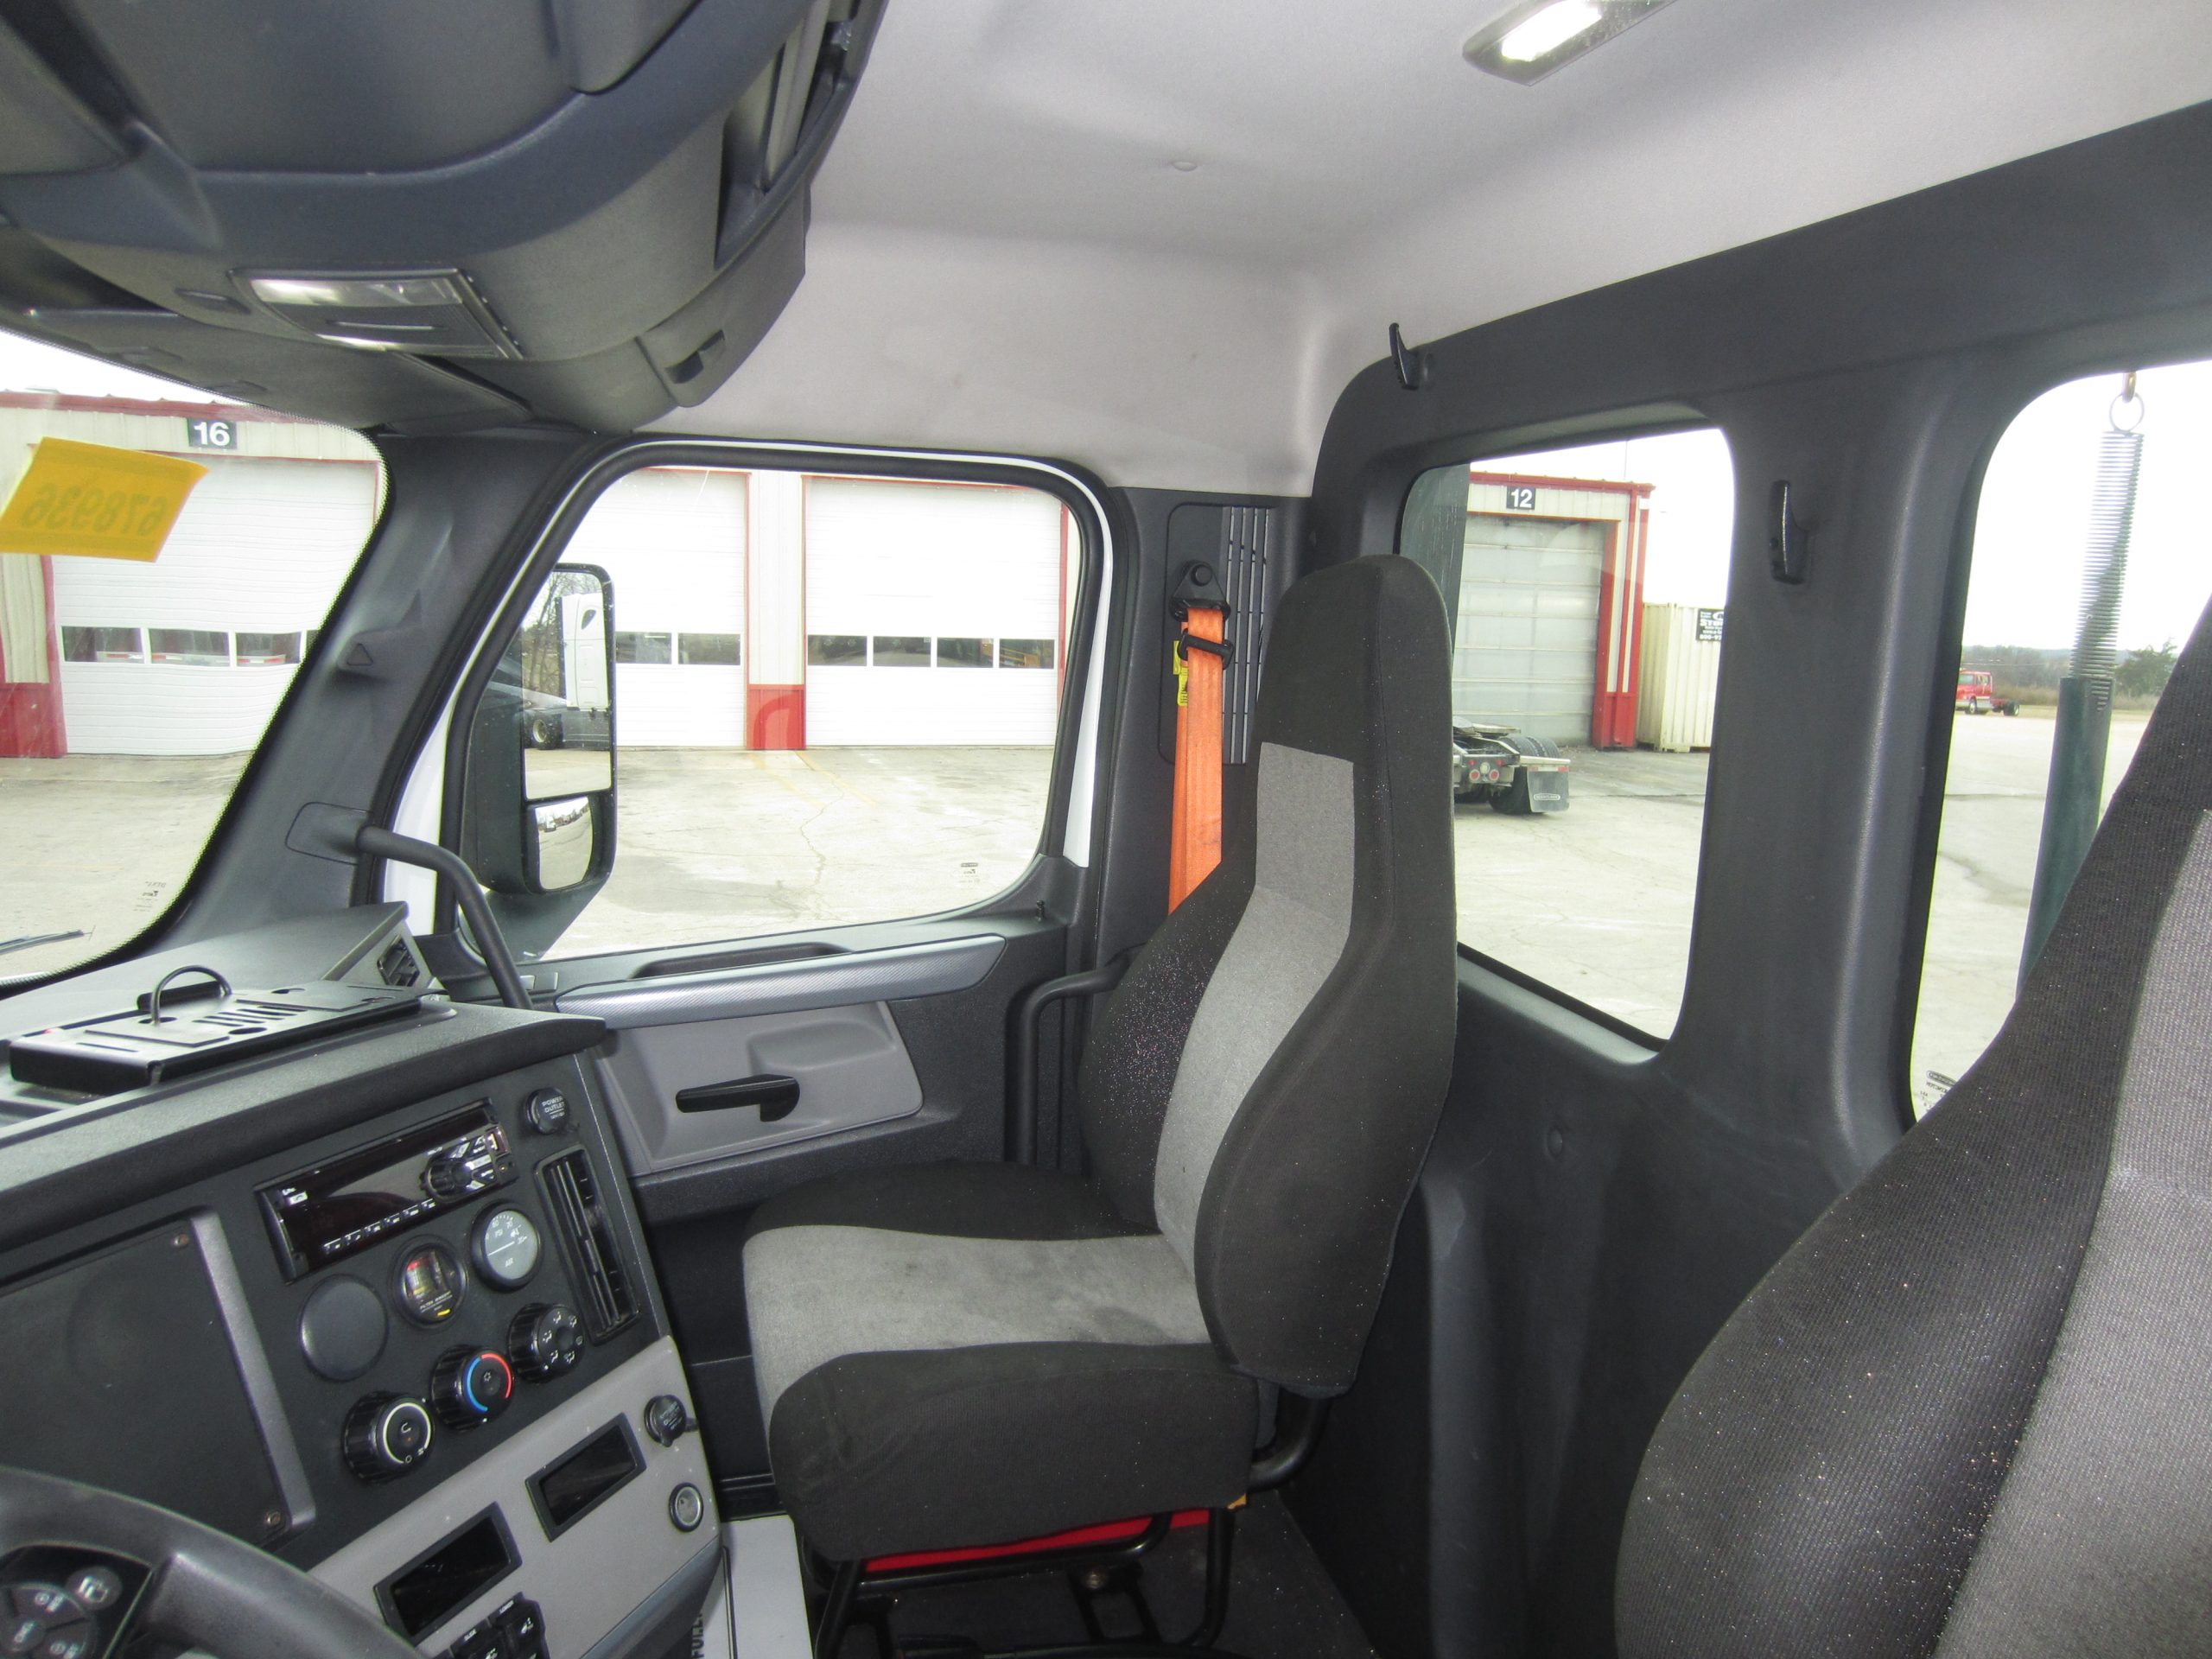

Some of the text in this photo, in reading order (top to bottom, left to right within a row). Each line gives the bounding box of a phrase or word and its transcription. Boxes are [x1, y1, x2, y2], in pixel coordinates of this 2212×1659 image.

[193, 421, 231, 447] 16
[1510, 488, 1533, 508] 12
[541, 1096, 563, 1107] POWER
[544, 1101, 565, 1113] OUTLET
